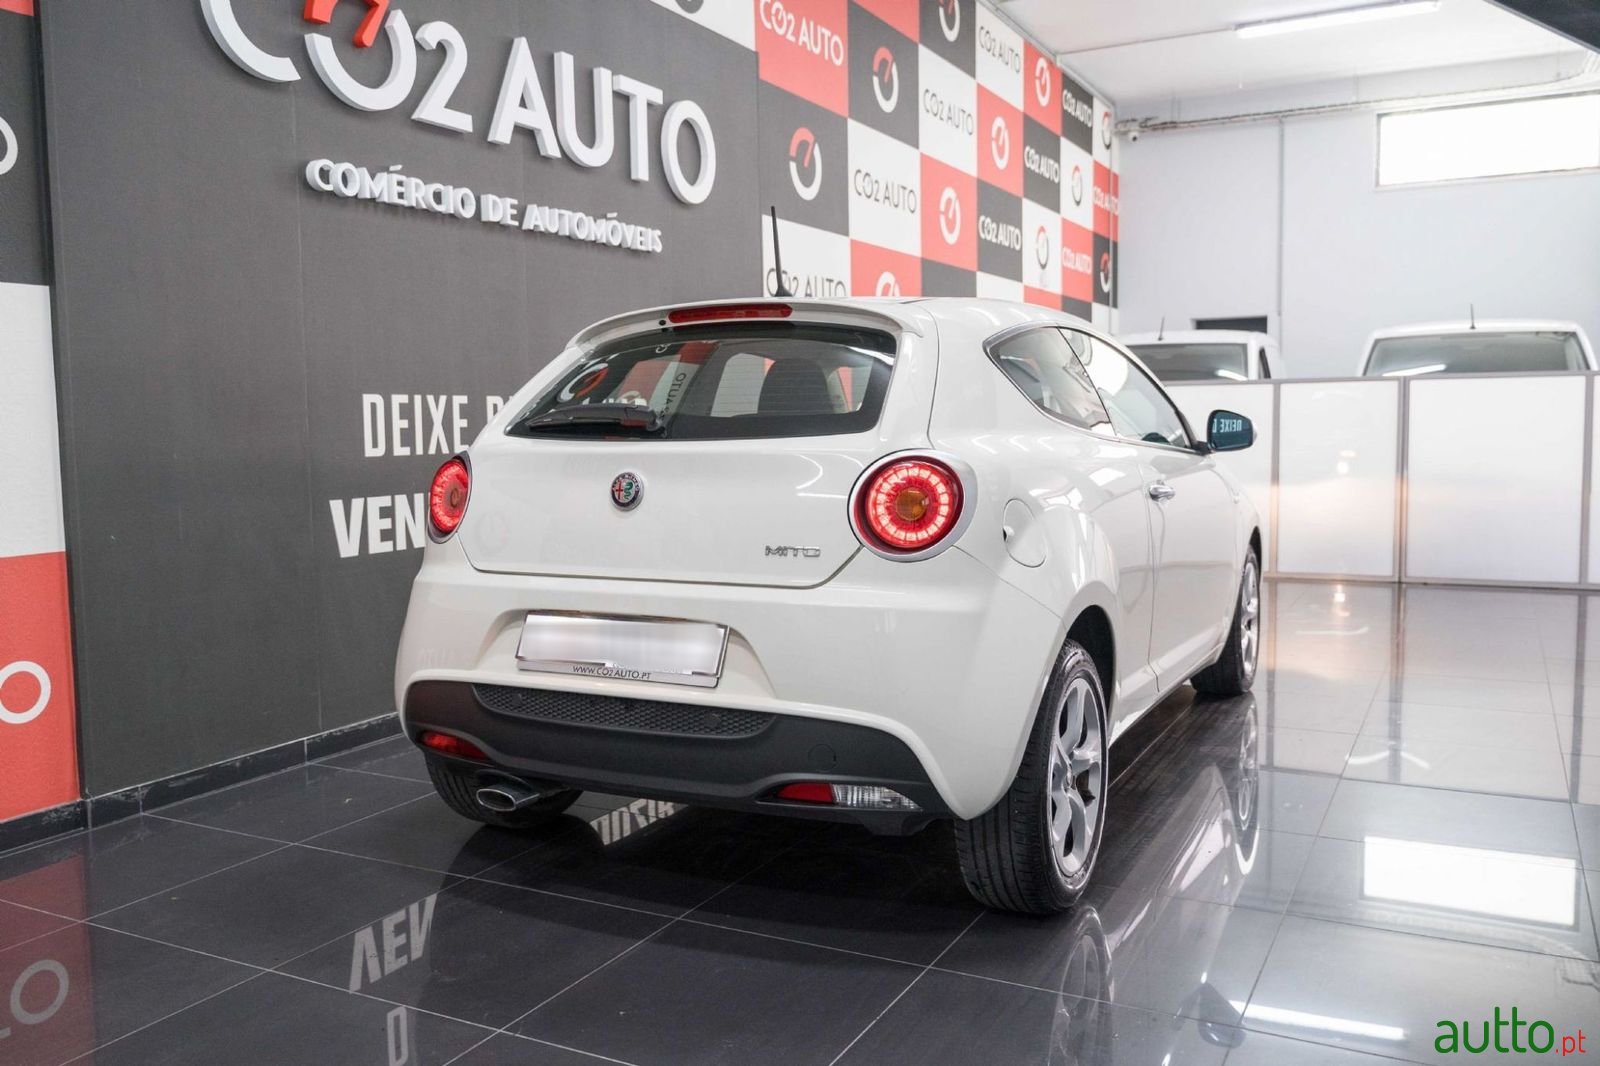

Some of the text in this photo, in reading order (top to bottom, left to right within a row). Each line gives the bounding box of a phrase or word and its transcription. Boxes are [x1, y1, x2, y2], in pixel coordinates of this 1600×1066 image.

[760, 0, 844, 66] CO2 AUTO
[979, 26, 1021, 74] CO2 AUTO
[488, 36, 717, 205] AUTO
[923, 88, 975, 136] CO2 AUTO
[1075, 100, 1092, 128] AUTO
[1024, 146, 1060, 184] CO2 AUTO
[306, 158, 663, 254] COMÉRCIO DE AUTOMÓVEIS
[854, 168, 918, 214] CO2 AUTO
[979, 214, 1022, 251] CO2 AUTO
[766, 267, 799, 297] C2
[1075, 252, 1092, 275] AUTO
[362, 393, 470, 458] DEIXE
[329, 493, 431, 558] VEN
